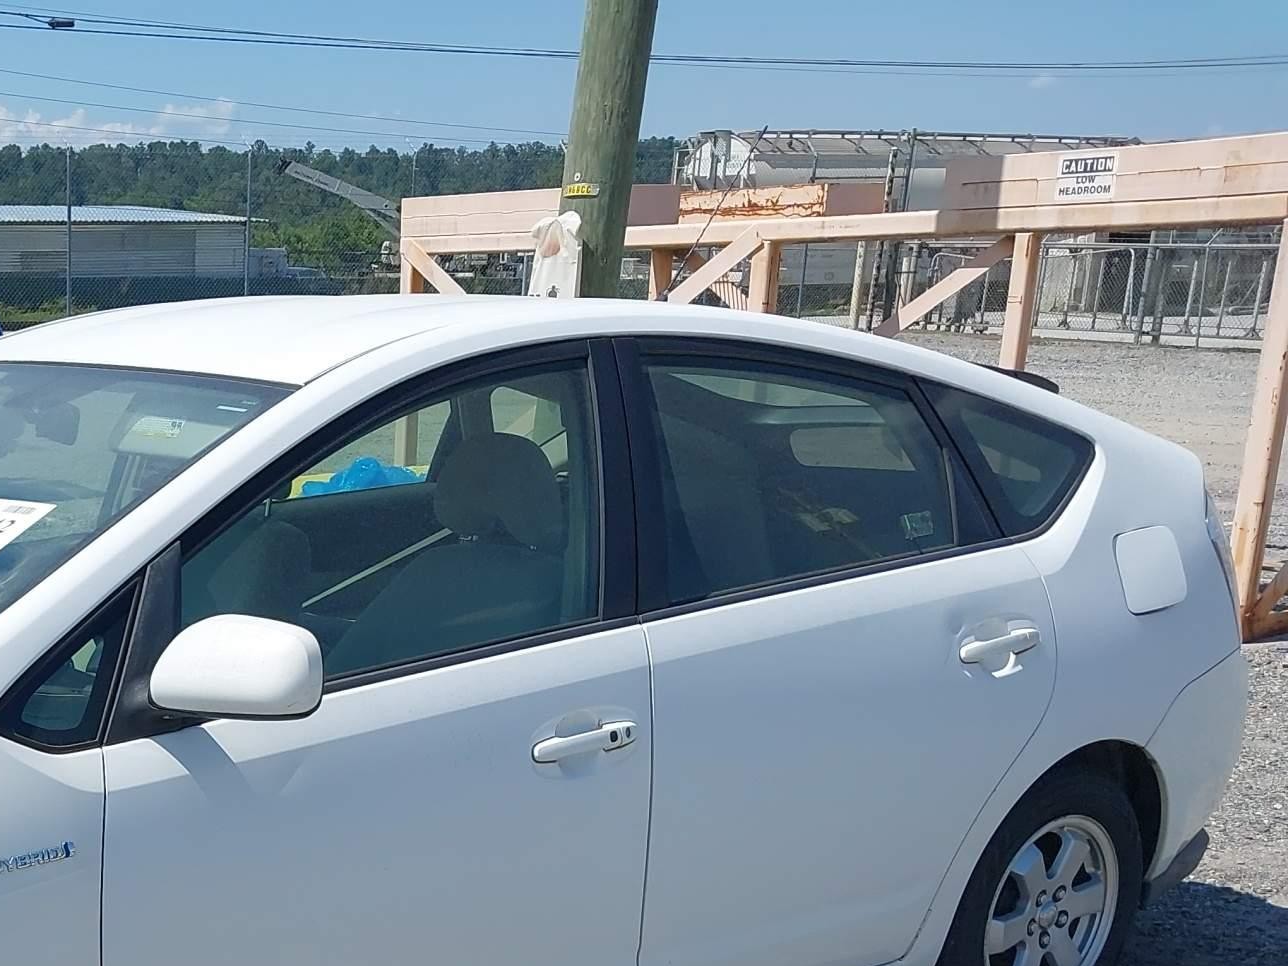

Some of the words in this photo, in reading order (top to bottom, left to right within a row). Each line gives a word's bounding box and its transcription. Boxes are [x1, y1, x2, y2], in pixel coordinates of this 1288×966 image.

[1062, 157, 1114, 173] CAUTION
[1076, 175, 1097, 185] LOW
[1058, 184, 1111, 196] HEADROOM
